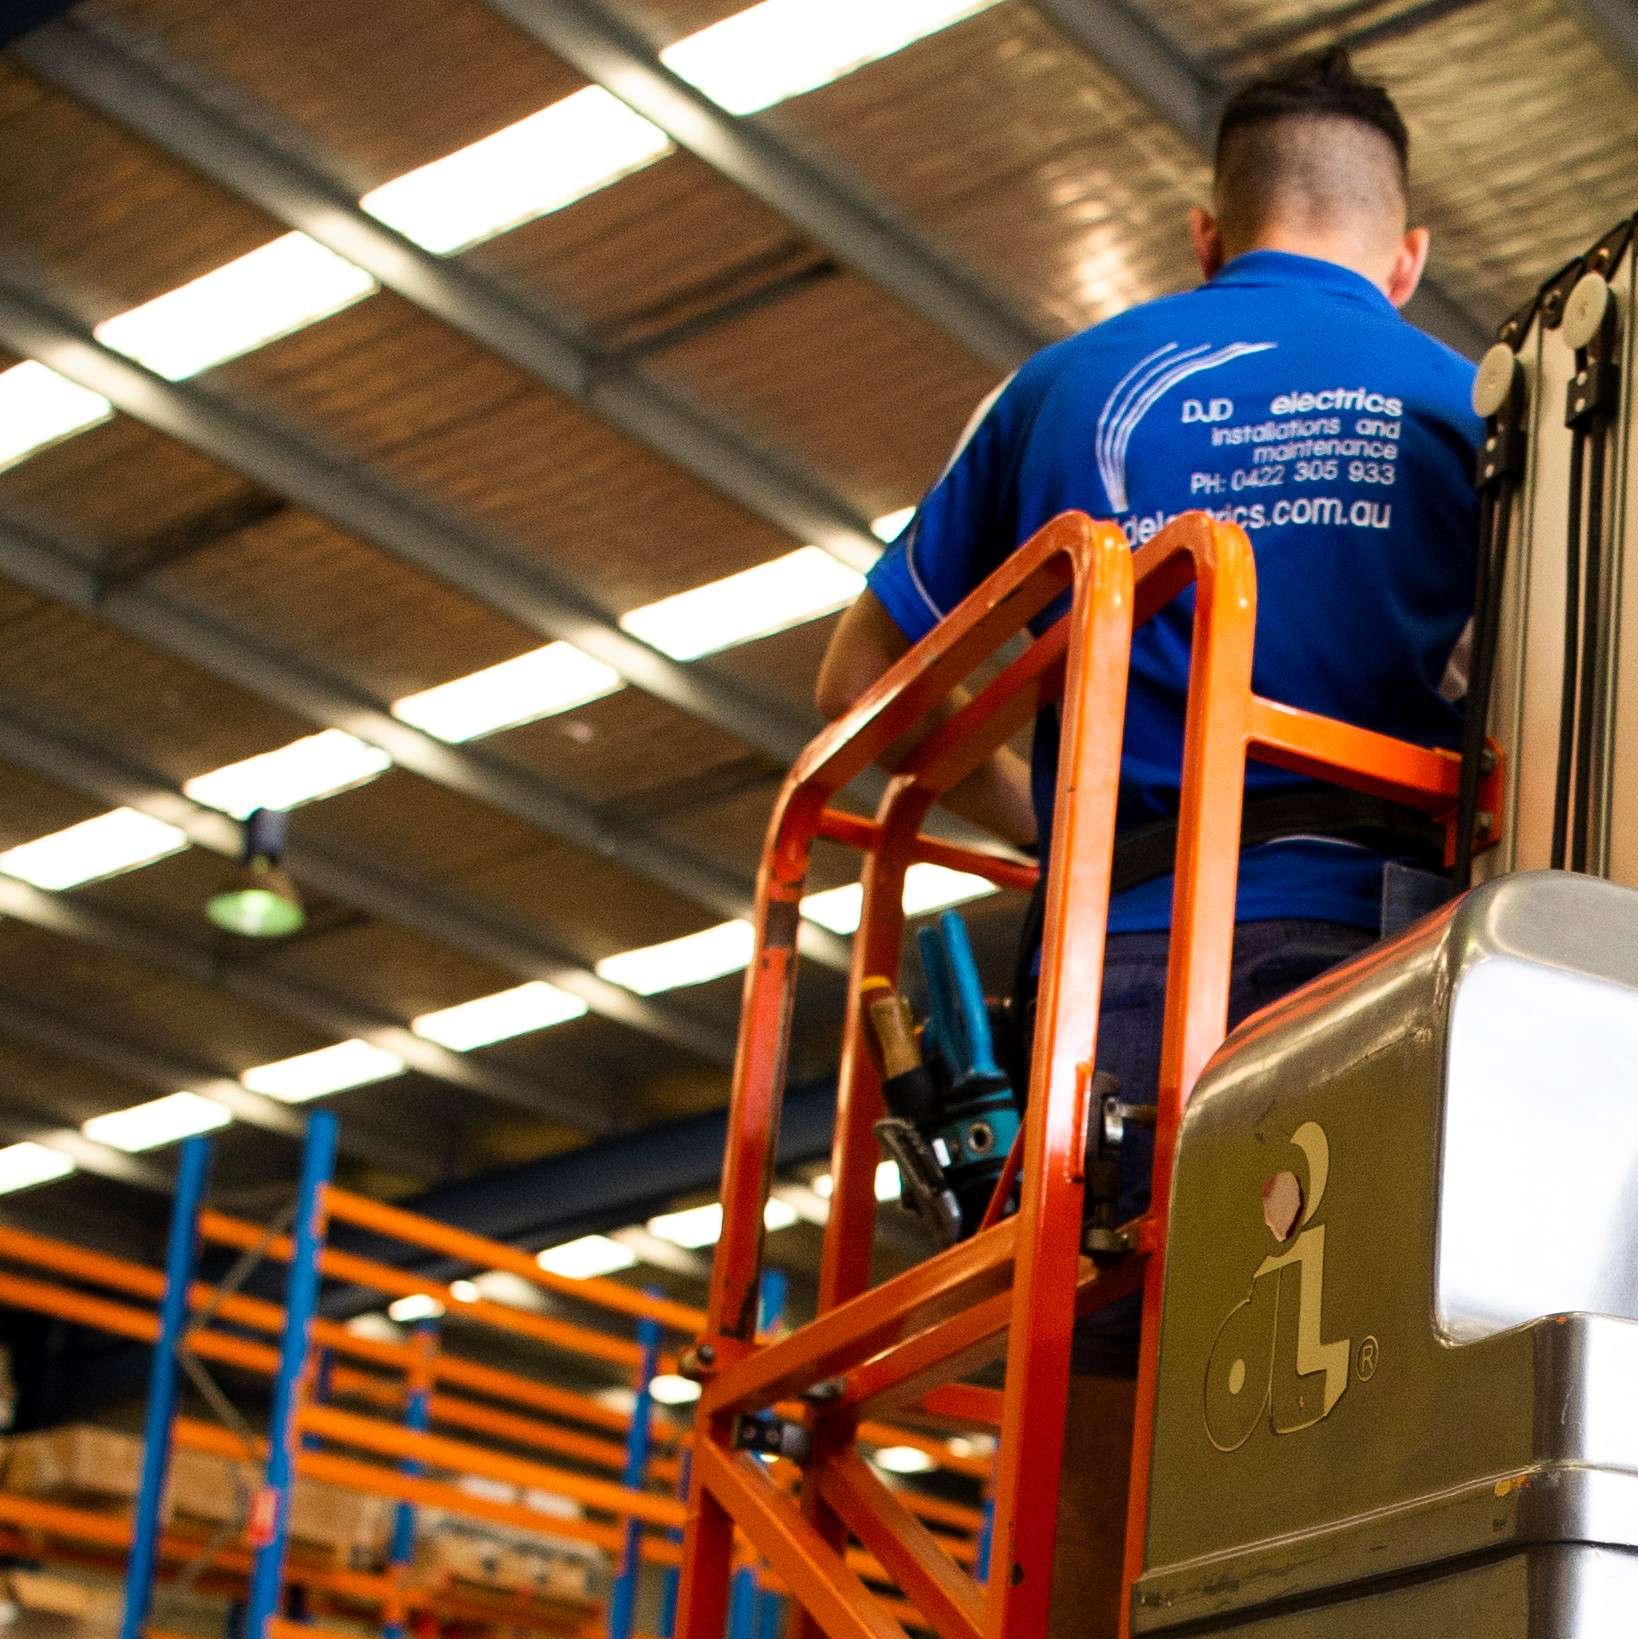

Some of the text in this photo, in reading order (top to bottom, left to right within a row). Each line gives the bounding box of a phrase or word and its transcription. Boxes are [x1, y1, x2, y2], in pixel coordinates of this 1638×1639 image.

[1181, 387, 1403, 423] DJD electrics
[1355, 417, 1401, 440] and
[1252, 437, 1398, 465] maintenance
[1231, 464, 1286, 491] 0422
[1294, 459, 1339, 482] 305
[1348, 460, 1396, 486] 933
